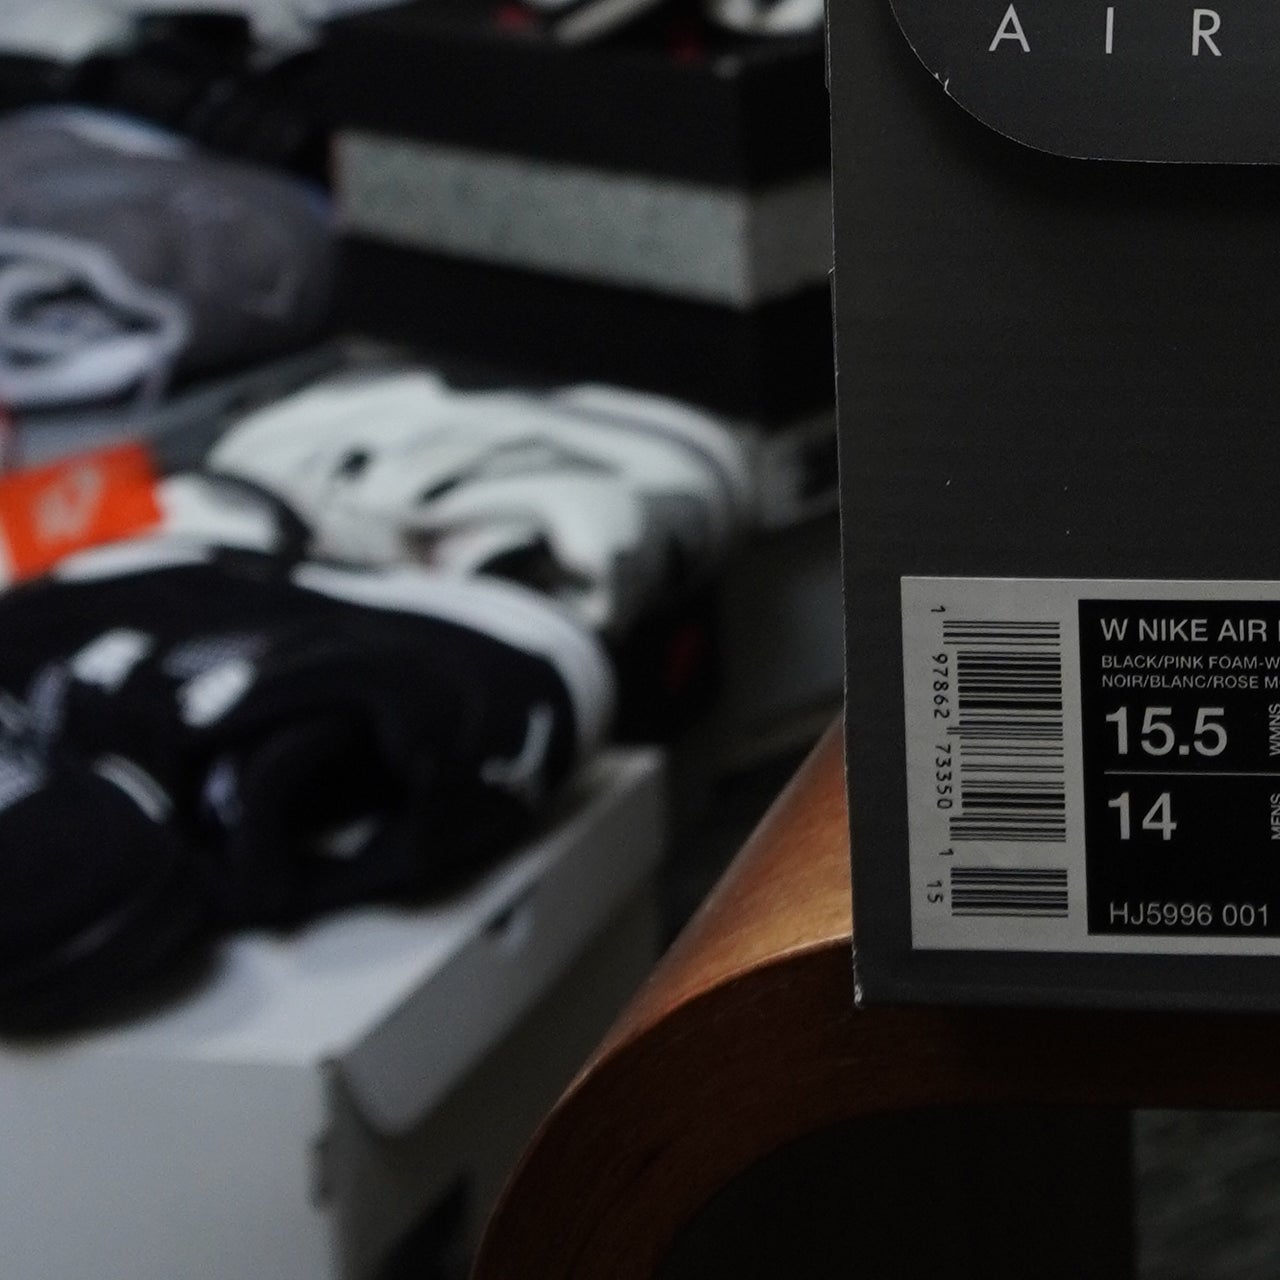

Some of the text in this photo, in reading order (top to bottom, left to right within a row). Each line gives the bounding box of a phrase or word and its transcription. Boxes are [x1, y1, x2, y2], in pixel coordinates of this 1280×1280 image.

[988, 3, 1222, 56] AIR
[1100, 618, 1128, 641] W
[1139, 618, 1208, 642] NIKE
[1217, 619, 1267, 642] AIR
[1101, 655, 1203, 669] BLACK/PINK
[1101, 674, 1259, 689] NOIR/BLANC/ROSE
[931, 605, 954, 856] 1 97862 73350 1
[1105, 706, 1227, 756] 15.5
[1107, 791, 1177, 840] 14
[926, 880, 944, 903] 15
[1109, 902, 1268, 927] HJ5996 001
